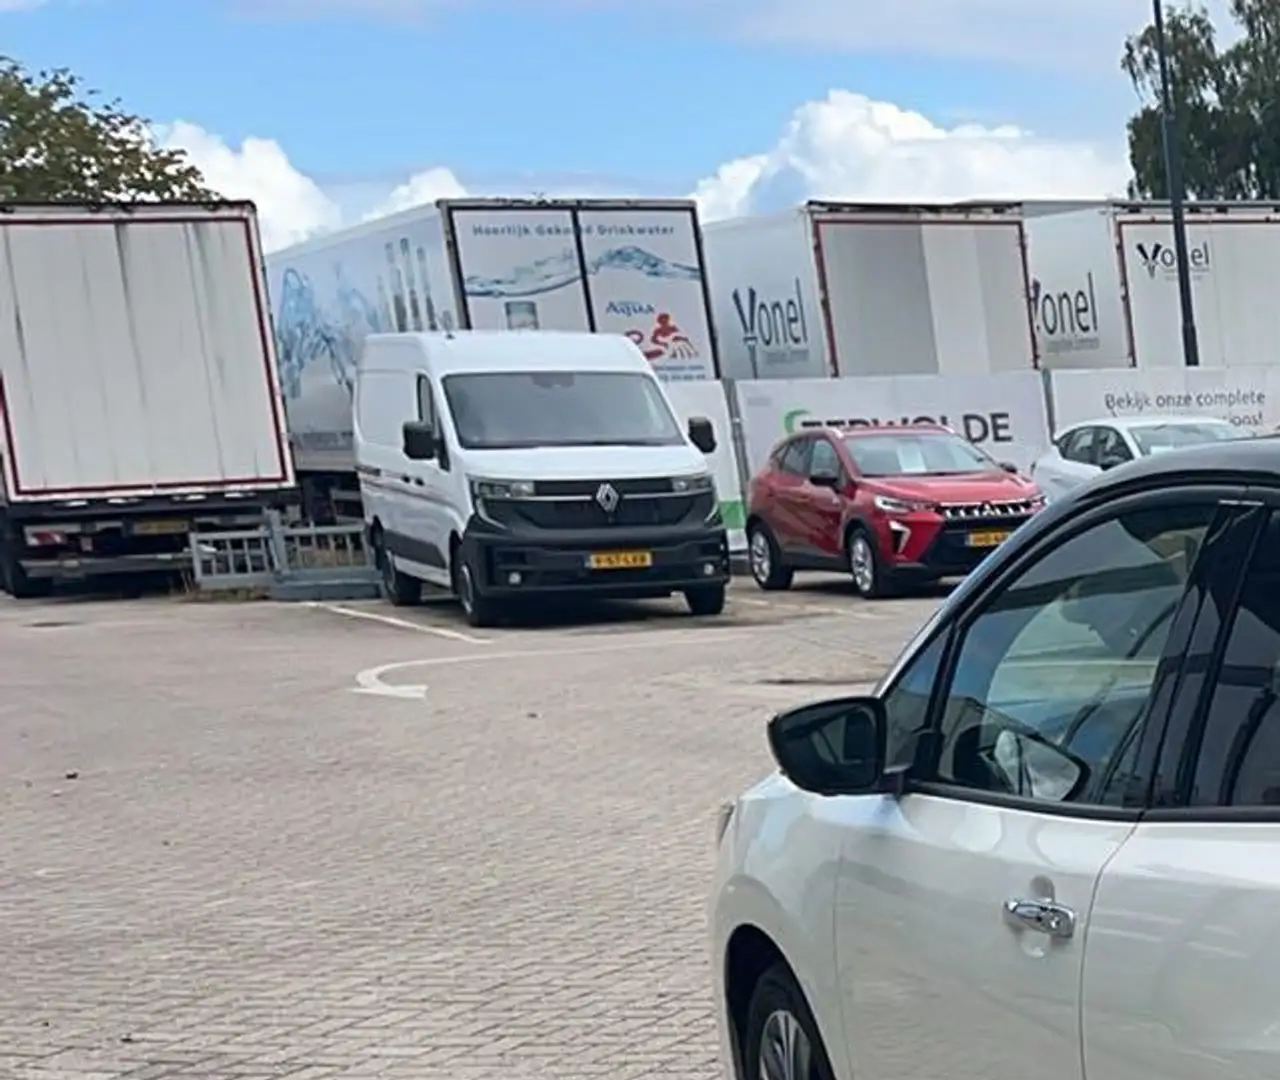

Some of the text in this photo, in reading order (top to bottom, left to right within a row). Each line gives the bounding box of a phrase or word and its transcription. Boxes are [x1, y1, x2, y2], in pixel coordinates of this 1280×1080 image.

[1136, 241, 1210, 278] Voel
[606, 301, 656, 318] Aqua
[732, 277, 808, 378] Vonel
[1155, 393, 1193, 408] onze
[1197, 389, 1266, 411] complete
